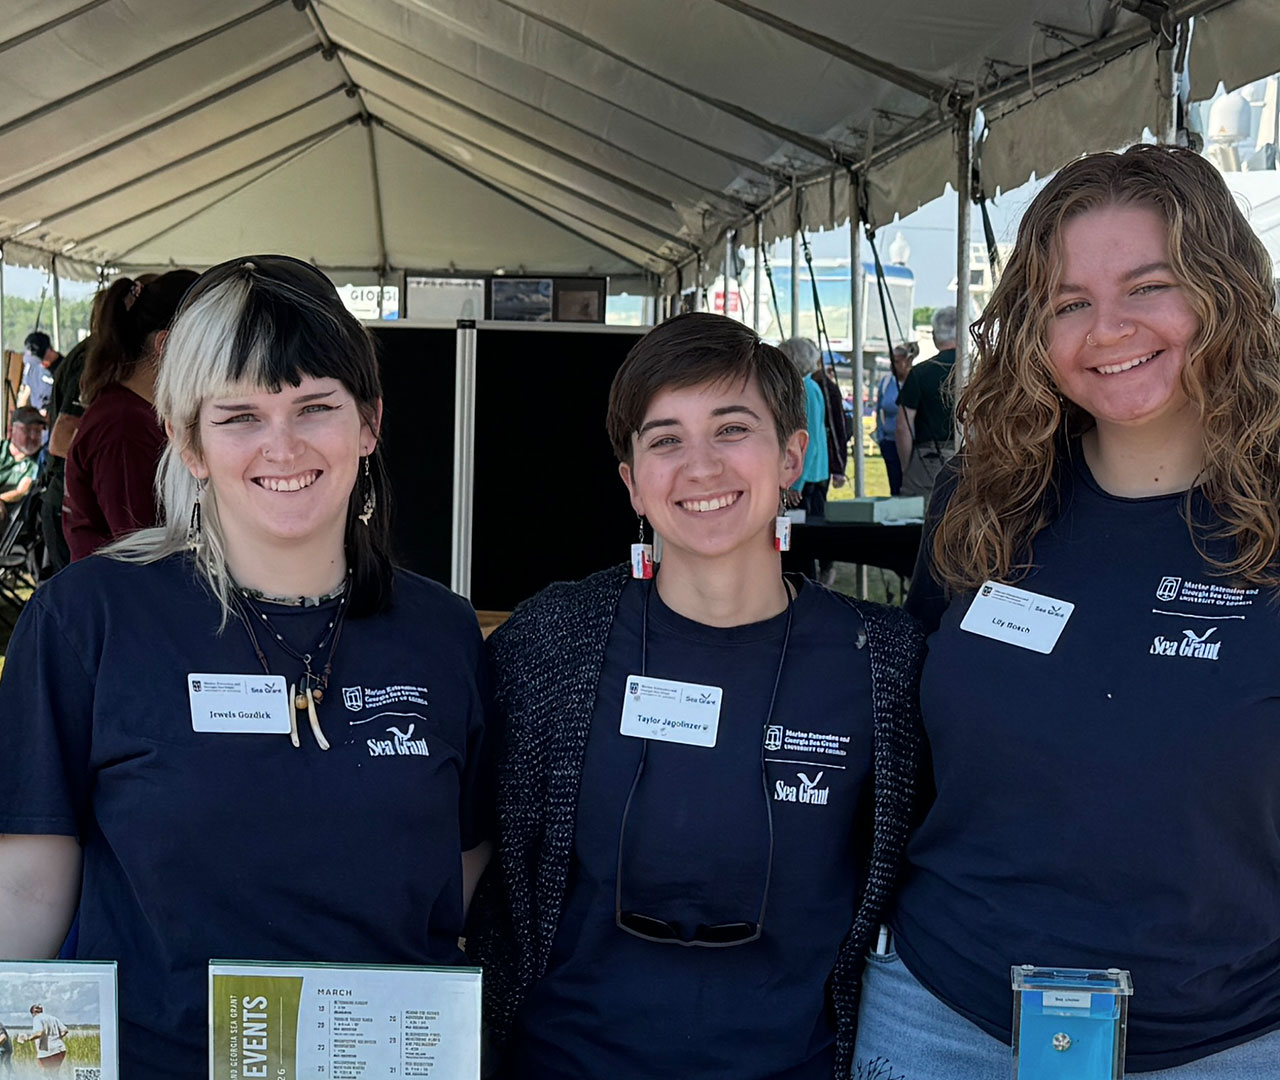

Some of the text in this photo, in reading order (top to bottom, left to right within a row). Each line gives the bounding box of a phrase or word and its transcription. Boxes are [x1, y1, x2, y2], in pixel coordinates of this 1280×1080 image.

[1149, 636, 1222, 660] Sea Grant
[637, 714, 661, 725] Taylor
[366, 736, 429, 756] Sea Grant
[774, 780, 829, 805] Sea Grant
[317, 988, 353, 997] MARCH
[230, 994, 238, 1018] GRANT
[230, 1021, 238, 1034] SEA
[242, 995, 268, 1078] EVENTS
[230, 1036, 238, 1067] GEORGIA
